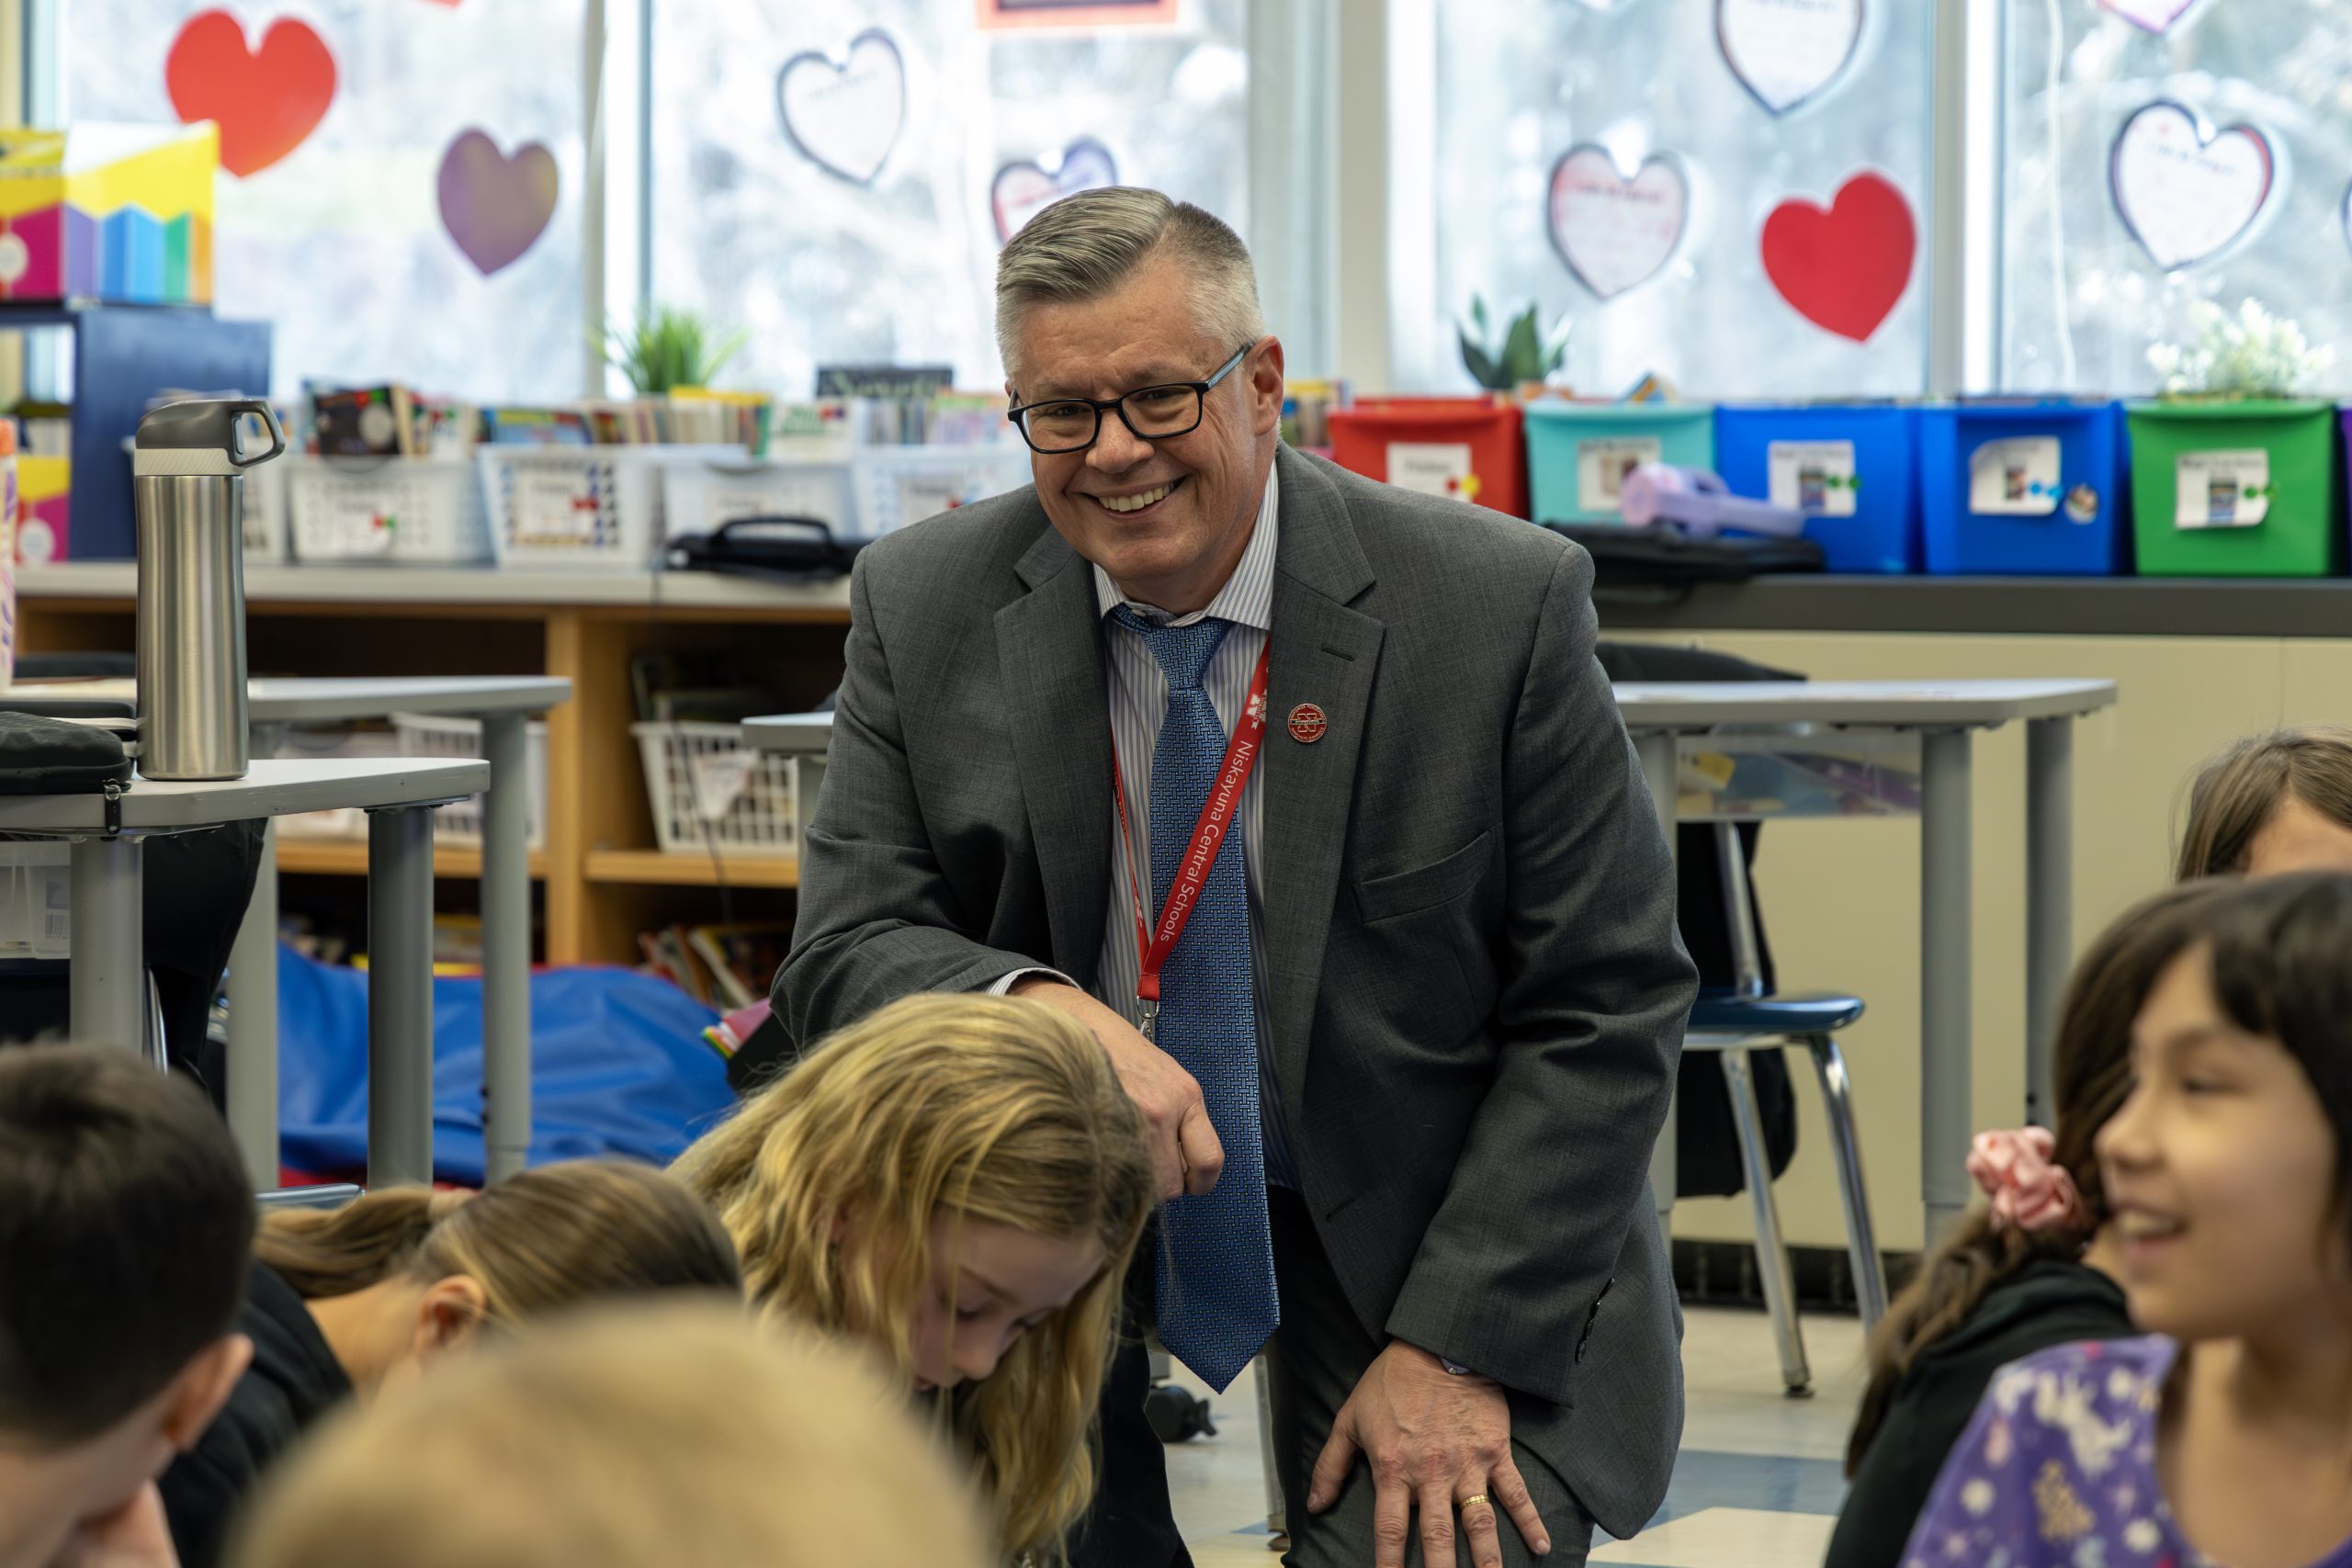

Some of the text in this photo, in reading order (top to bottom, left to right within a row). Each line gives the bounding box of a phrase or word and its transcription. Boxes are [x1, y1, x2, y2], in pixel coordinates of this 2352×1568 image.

[1160, 740, 1253, 942] Niskayuna Central Schools
